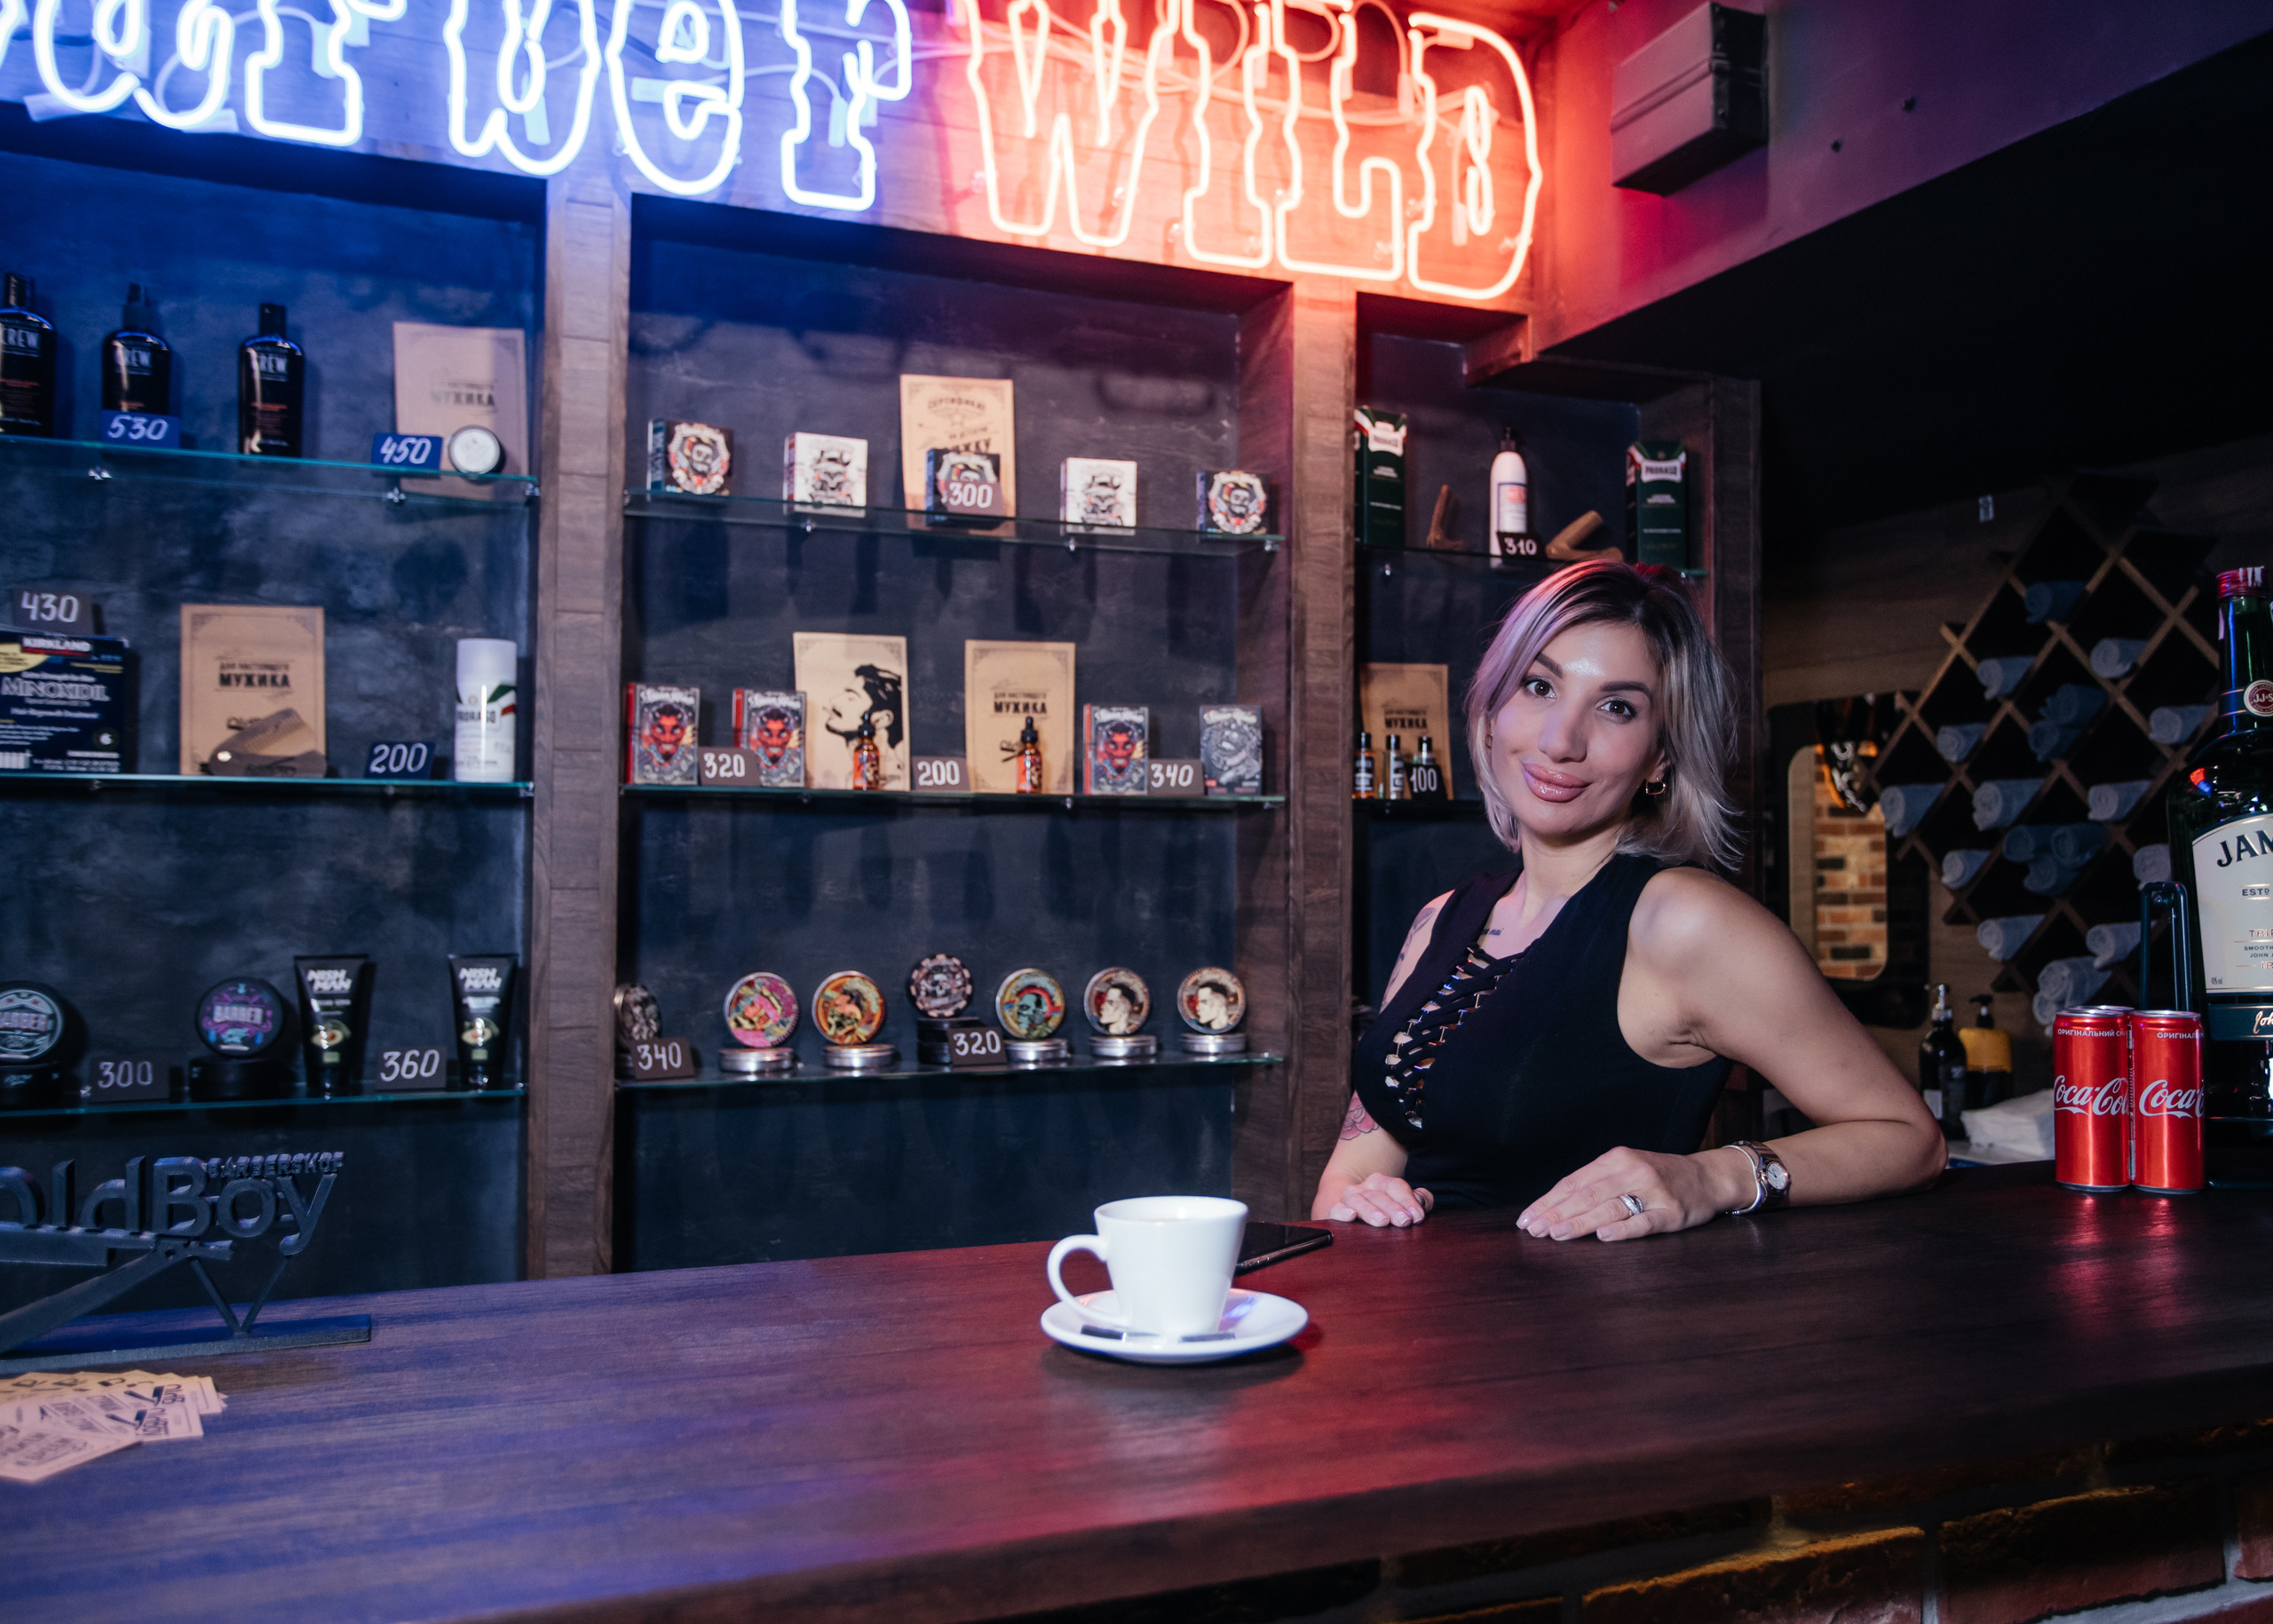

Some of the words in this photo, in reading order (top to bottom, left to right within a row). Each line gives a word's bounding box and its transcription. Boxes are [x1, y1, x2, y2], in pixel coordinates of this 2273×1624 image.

[966, 0, 1543, 300] WILD
[107, 414, 169, 440] 530
[380, 435, 432, 464] 450
[949, 482, 993, 509] 300
[1502, 535, 1538, 557] 310
[21, 591, 79, 622] 430
[1, 677, 111, 701] MINOXIDIL
[219, 673, 289, 687] МУЖИКА
[994, 701, 1047, 714] МУЖИКА
[1384, 717, 1427, 729] МУЖИКА
[369, 742, 428, 774] 200
[704, 752, 746, 779] 320
[917, 759, 960, 787] 200
[1150, 762, 1194, 788] 340
[1410, 766, 1437, 793] 100
[953, 1030, 1002, 1057] 320
[2057, 1028, 2115, 1037] ОРИГІНАЛЬНИЙ
[380, 1049, 440, 1082] 360
[637, 1042, 683, 1071] 340
[97, 1060, 153, 1089] 300
[2054, 1074, 2129, 1116] Coca-Col
[205, 1151, 345, 1178] BARBERSHOP
